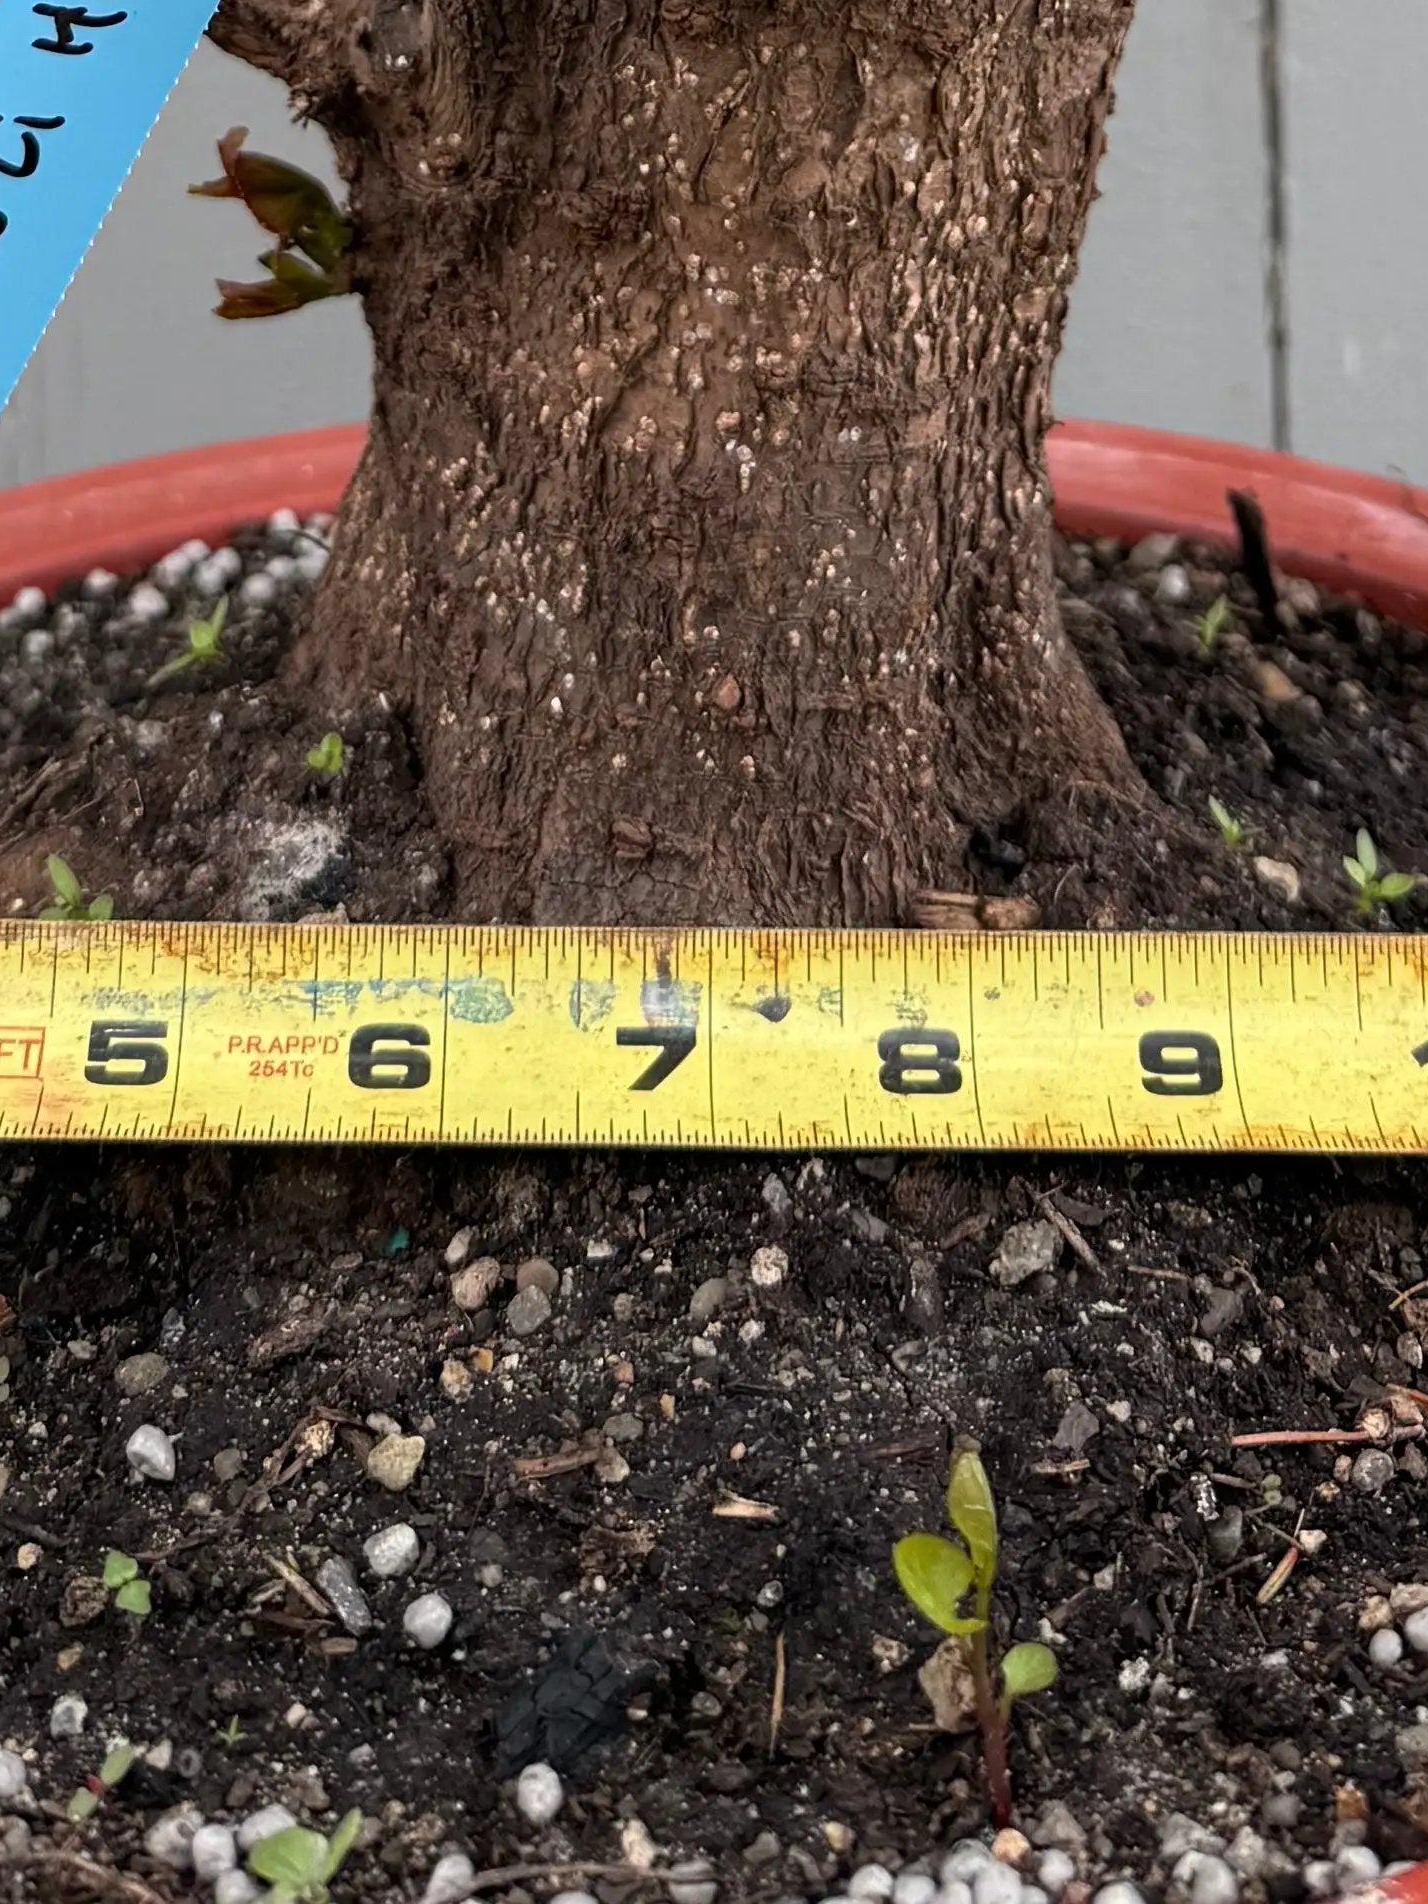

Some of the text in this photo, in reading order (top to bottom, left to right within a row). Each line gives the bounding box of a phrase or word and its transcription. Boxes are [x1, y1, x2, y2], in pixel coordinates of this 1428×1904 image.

[83, 1020, 170, 1087] 5
[347, 1023, 432, 1090] 6
[615, 1026, 698, 1091] 7
[877, 1028, 964, 1096] 8
[1138, 1030, 1225, 1097] 9
